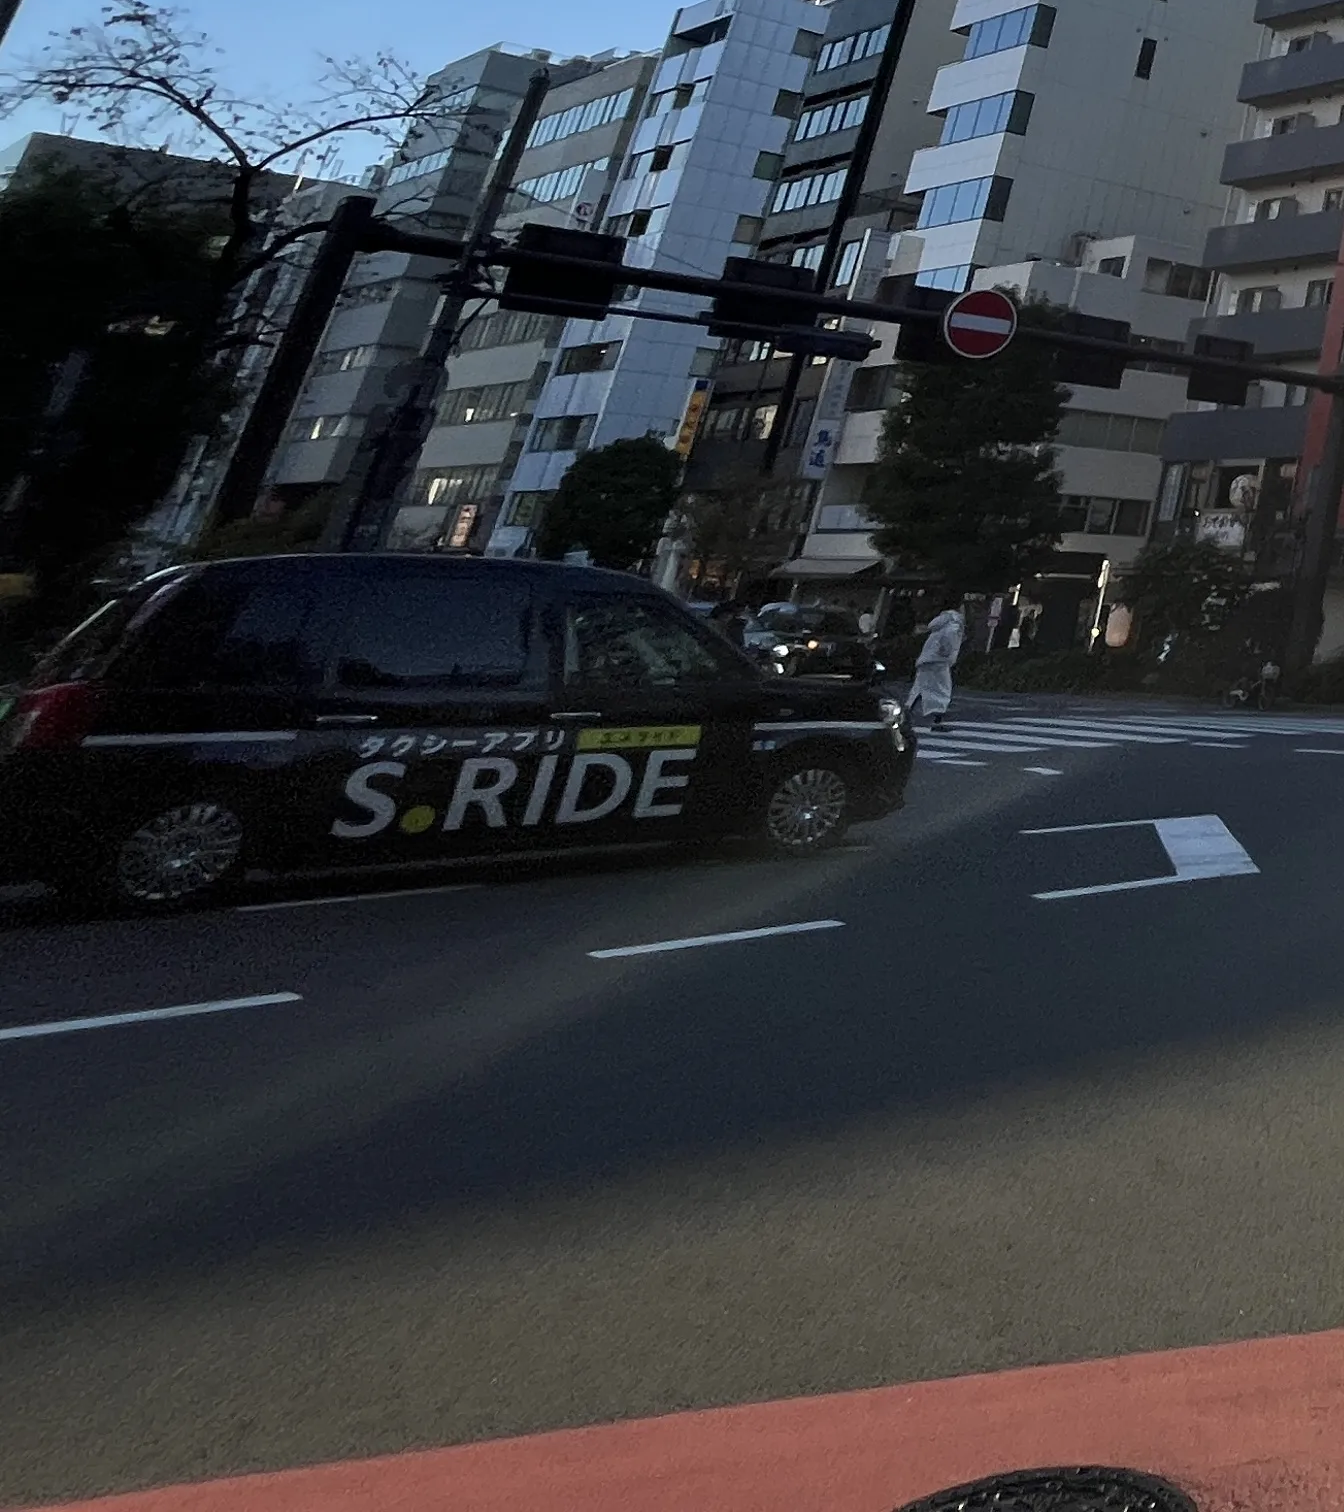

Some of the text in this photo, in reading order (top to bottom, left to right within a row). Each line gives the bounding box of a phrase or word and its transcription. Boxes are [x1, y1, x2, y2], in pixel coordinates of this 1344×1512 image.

[359, 729, 565, 758] タクシーアプリ
